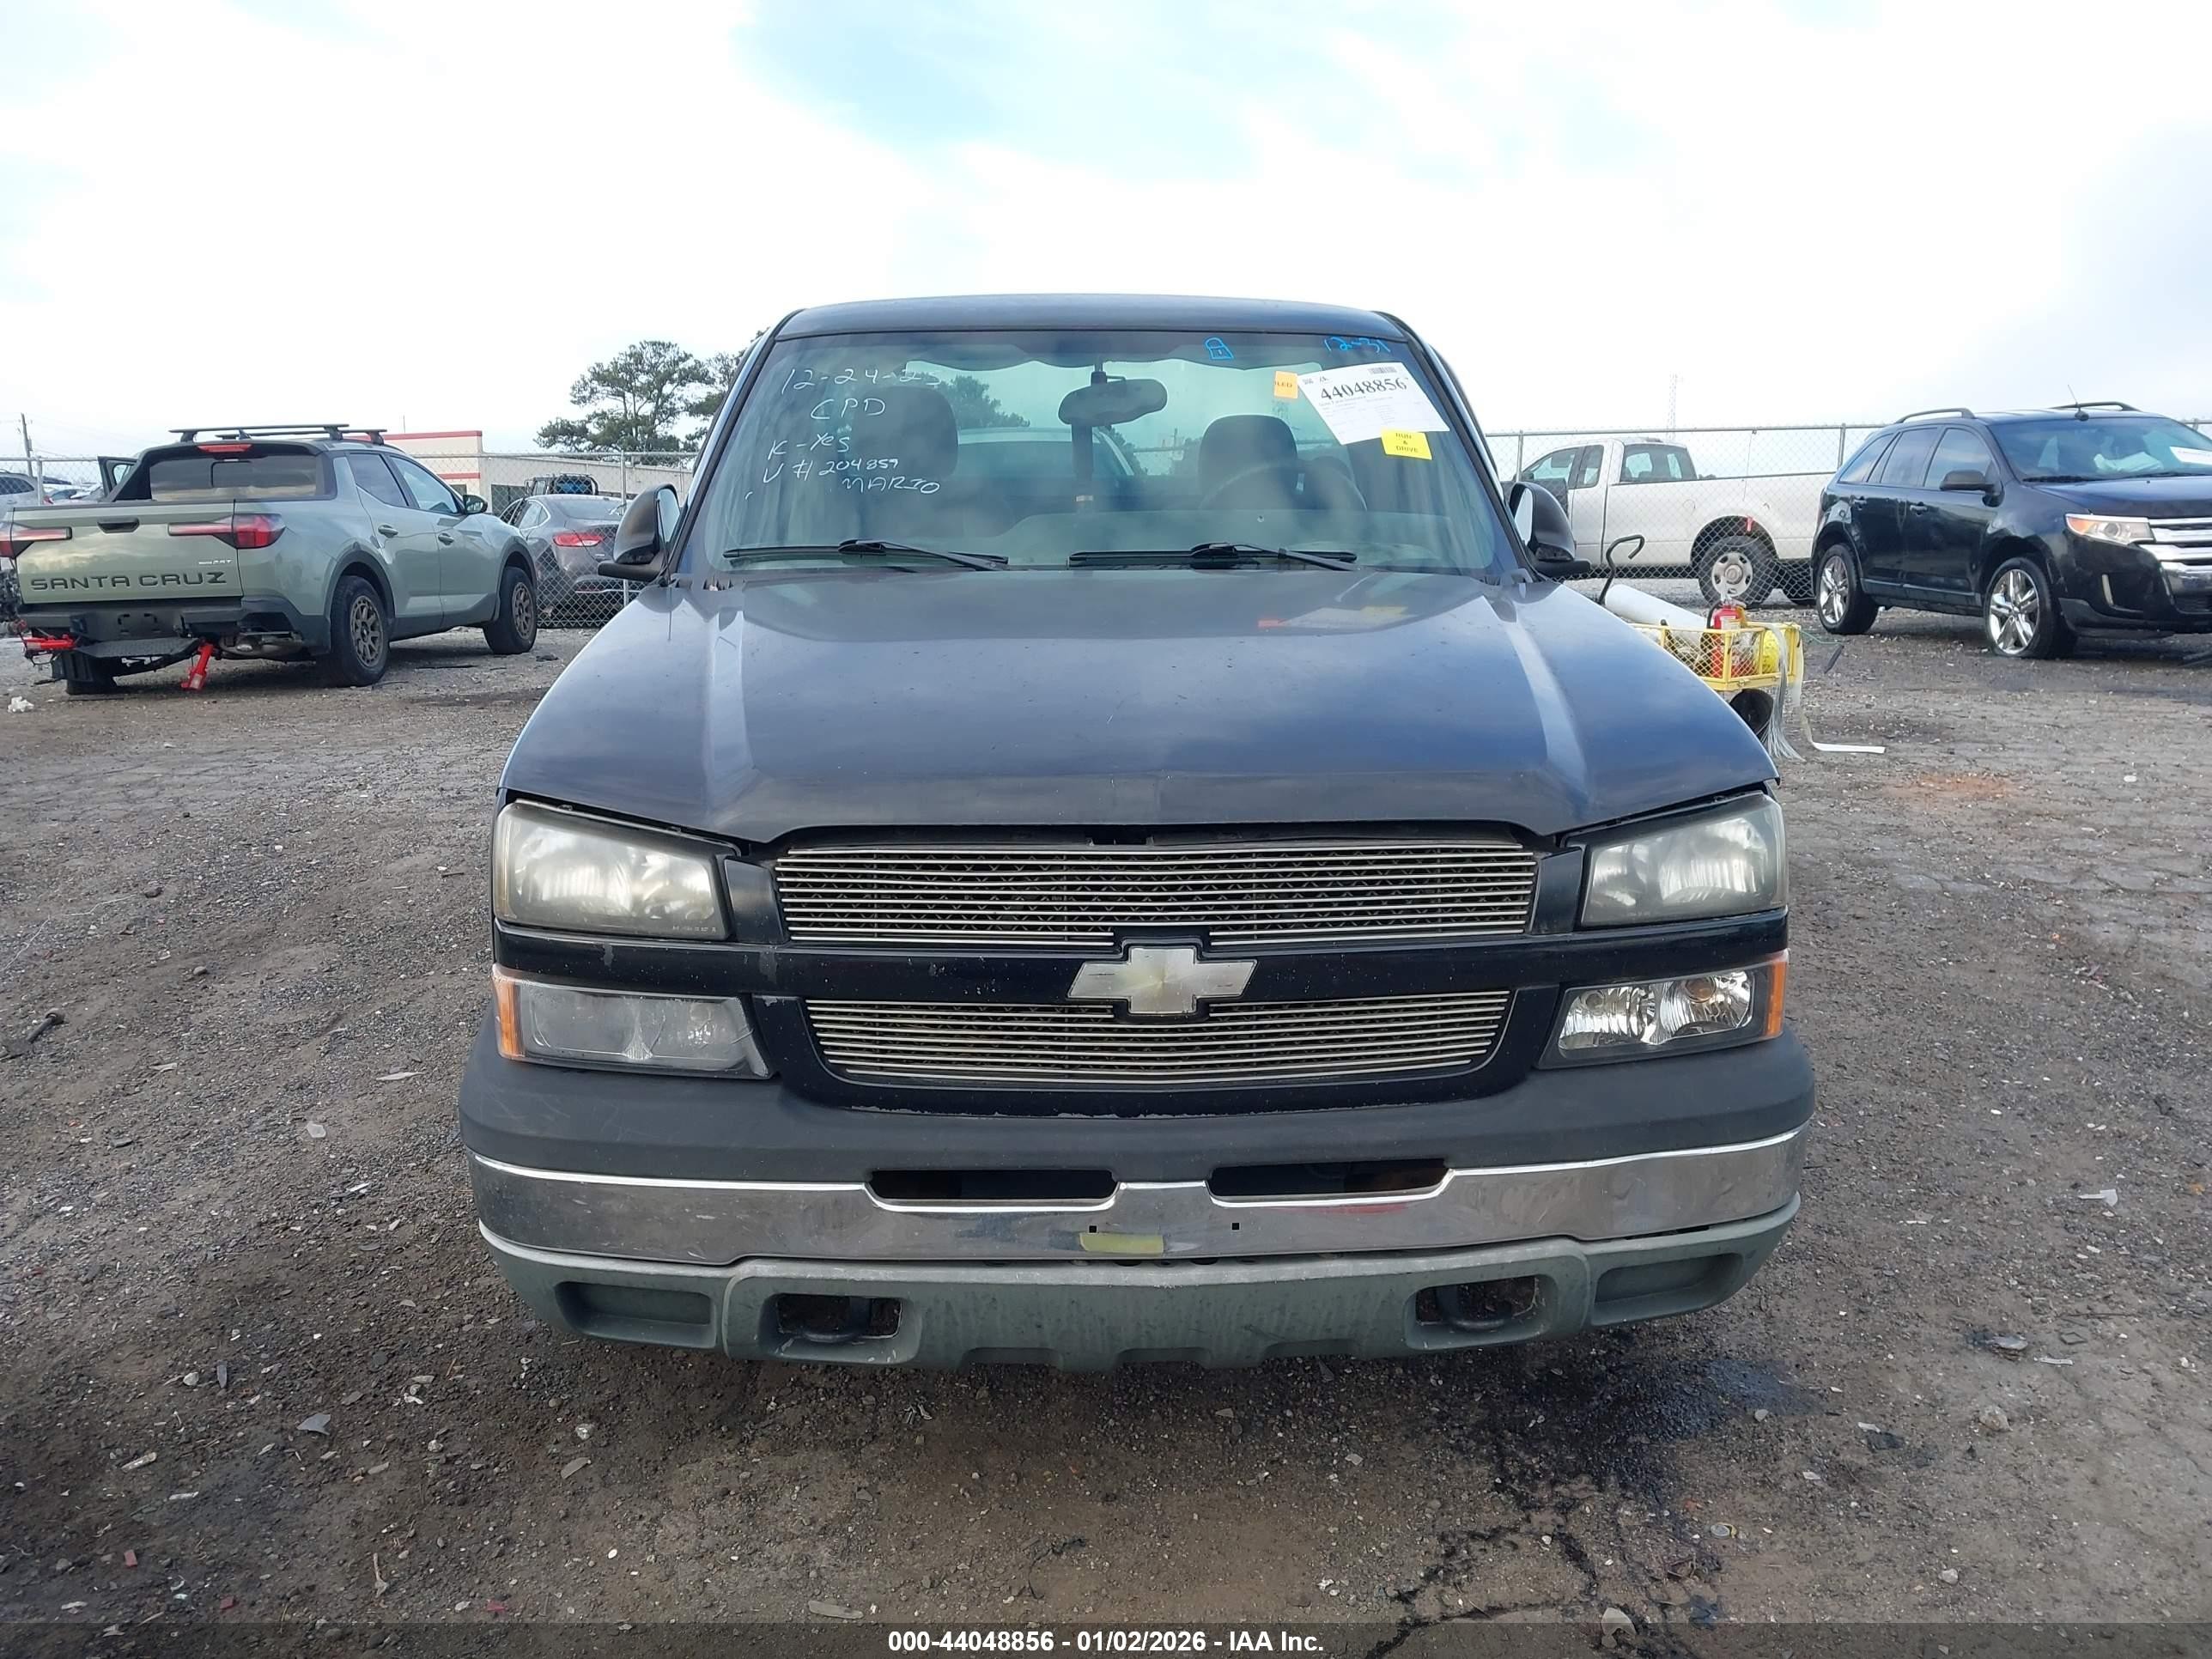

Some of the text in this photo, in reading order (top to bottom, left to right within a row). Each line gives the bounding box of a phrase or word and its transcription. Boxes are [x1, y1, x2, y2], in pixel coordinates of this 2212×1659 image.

[810, 398, 886, 420] CPD
[31, 571, 227, 591] SANTA CRUZ
